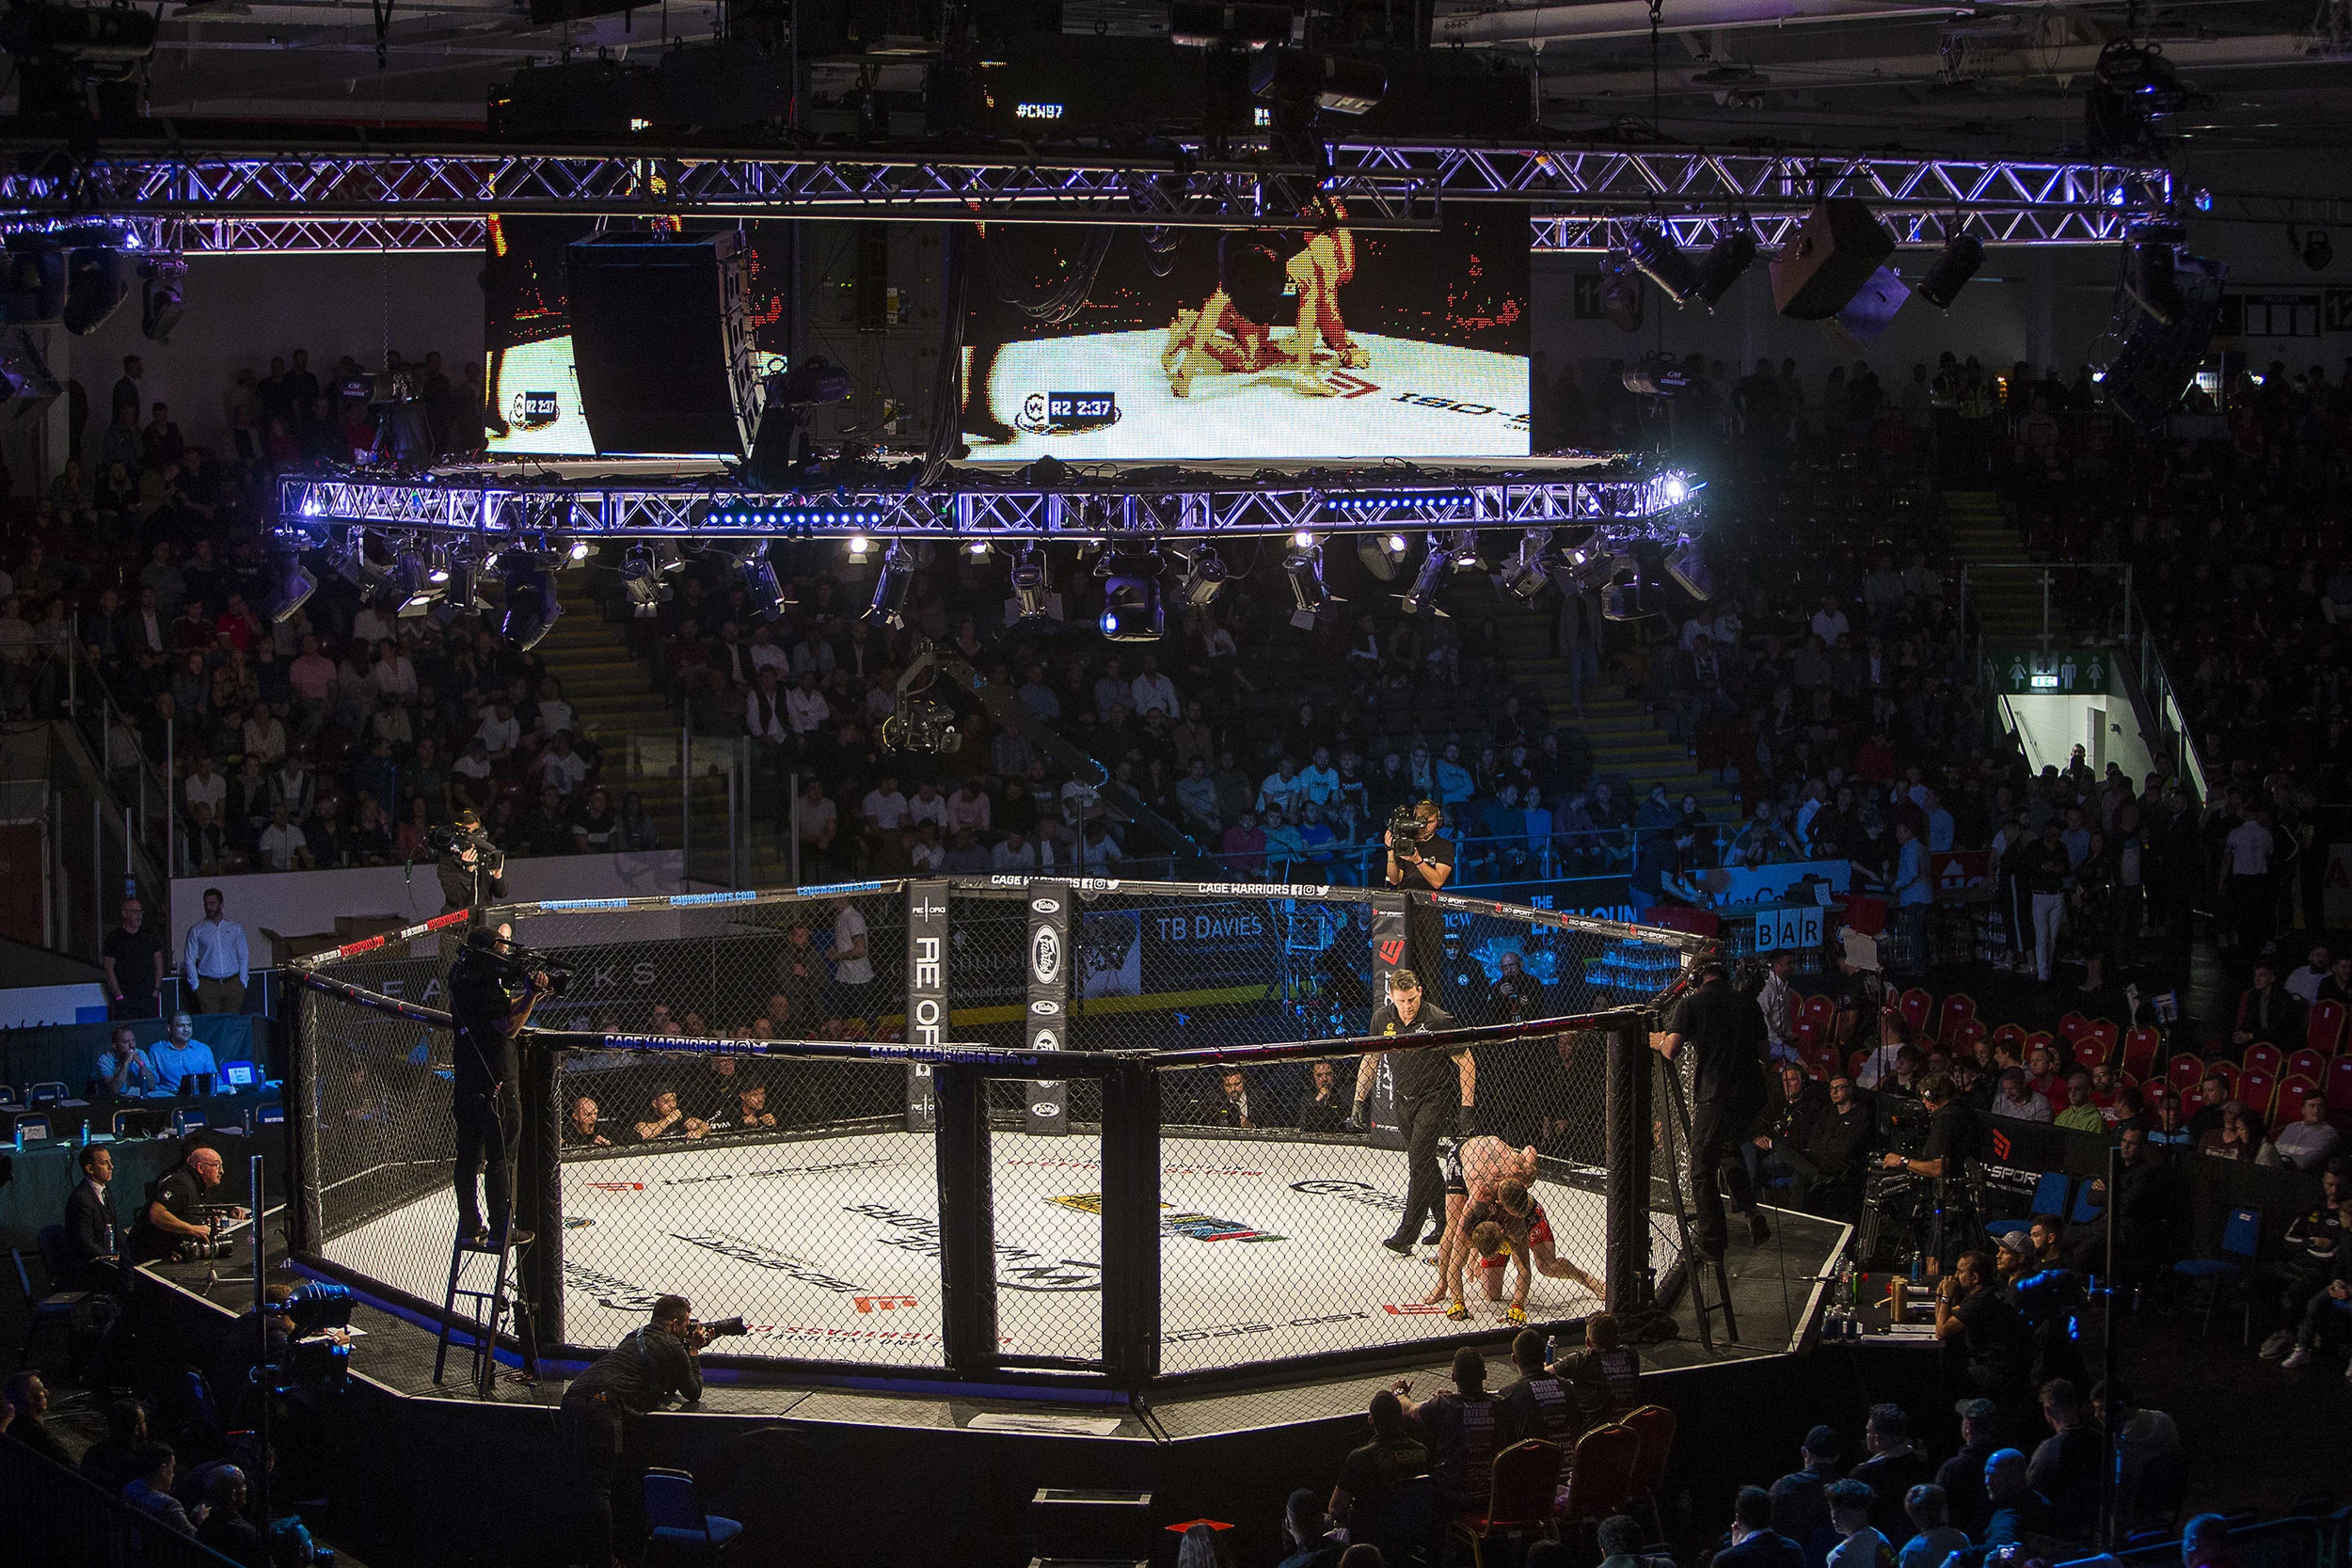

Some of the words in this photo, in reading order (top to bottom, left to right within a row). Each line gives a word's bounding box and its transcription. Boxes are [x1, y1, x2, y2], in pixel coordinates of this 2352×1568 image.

[1050, 400, 1072, 416] R2
[1076, 400, 1111, 416] 2:37
[796, 881, 882, 896] cagewarriors.com
[992, 875, 1022, 886] CAGE
[1199, 882, 1229, 894] CAGE
[1232, 883, 1289, 895] WARRIORS
[669, 890, 756, 906] cagewarriors.com
[1438, 895, 1469, 906] ISO-SPORT
[1531, 895, 1553, 910] THE
[1157, 917, 1186, 941] TB
[1759, 920, 1818, 945] BAR
[916, 938, 940, 989] RE
[605, 1035, 643, 1050] CAGE
[645, 1037, 718, 1053] WARRIORS
[1160, 1311, 1371, 1344] ISO-SPOR
